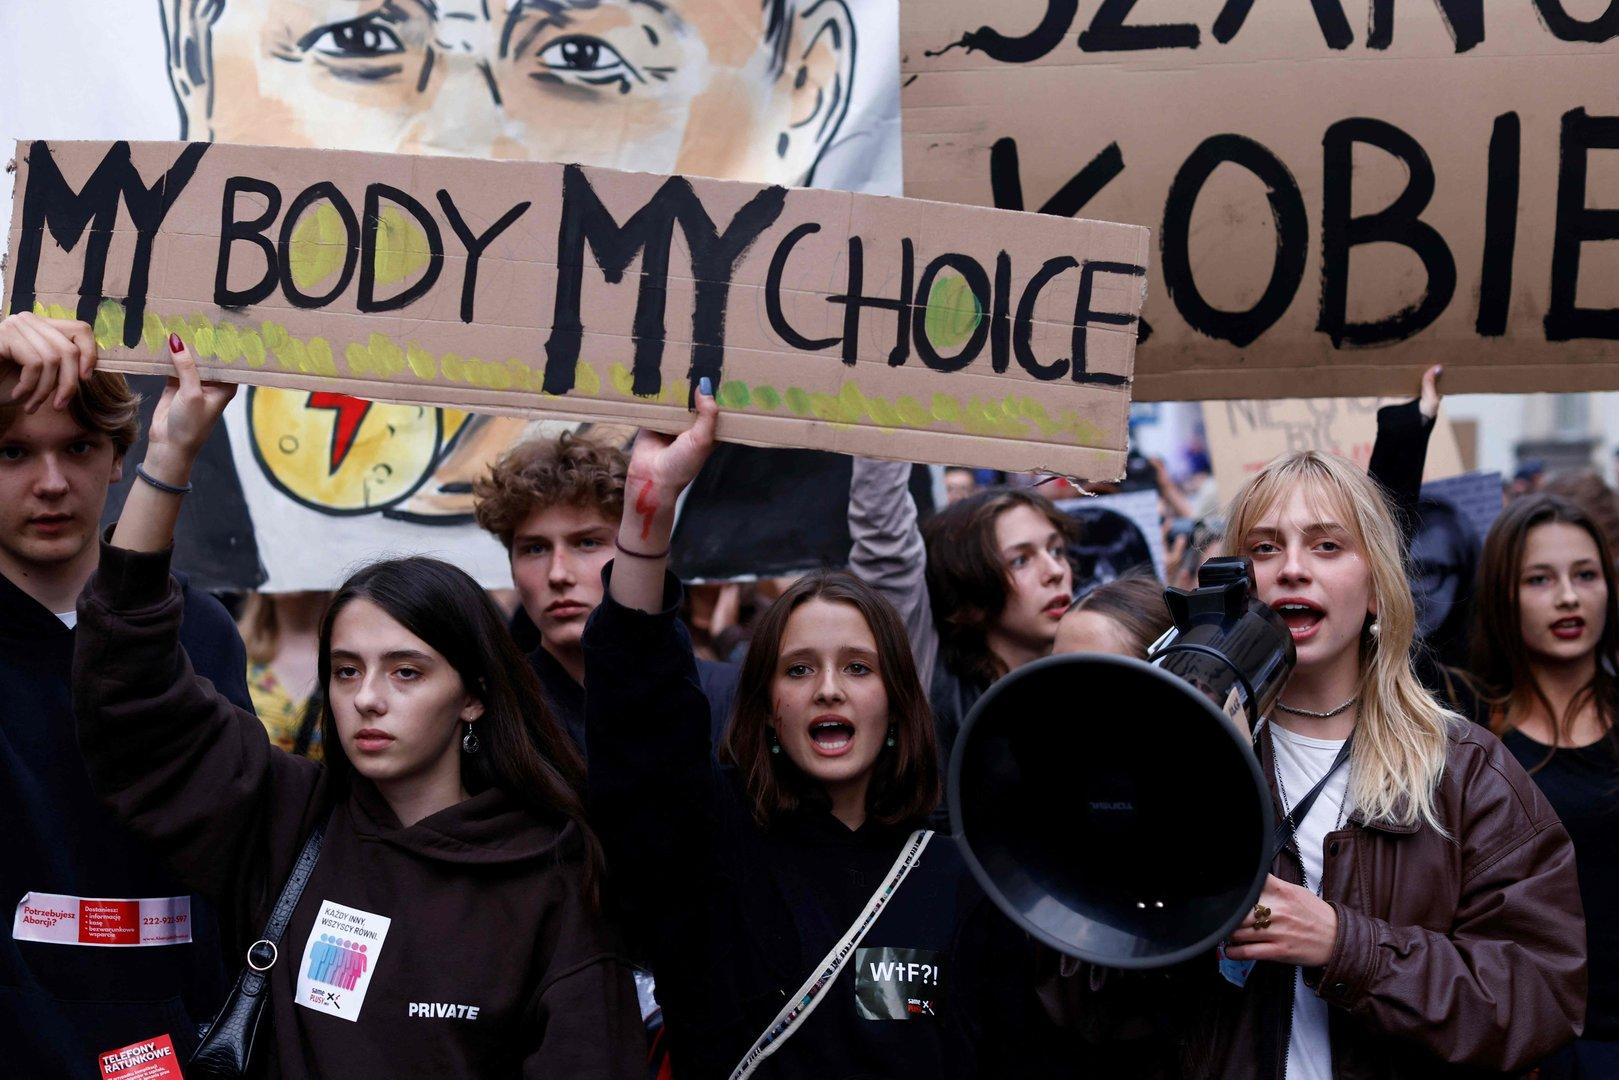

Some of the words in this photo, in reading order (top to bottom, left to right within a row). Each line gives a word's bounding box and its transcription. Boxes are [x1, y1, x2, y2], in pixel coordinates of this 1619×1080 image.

[10, 140, 211, 348] MY
[214, 176, 531, 324] BODY
[541, 164, 789, 412] MY
[765, 223, 1147, 385] CHOICE
[23, 915, 57, 927] Aborcji?
[24, 906, 76, 919] Potrzebujesz
[408, 1002, 480, 1020] PRIVATE
[102, 1042, 156, 1065] TELEFONY
[104, 1046, 171, 1074] RATUNKOWE
